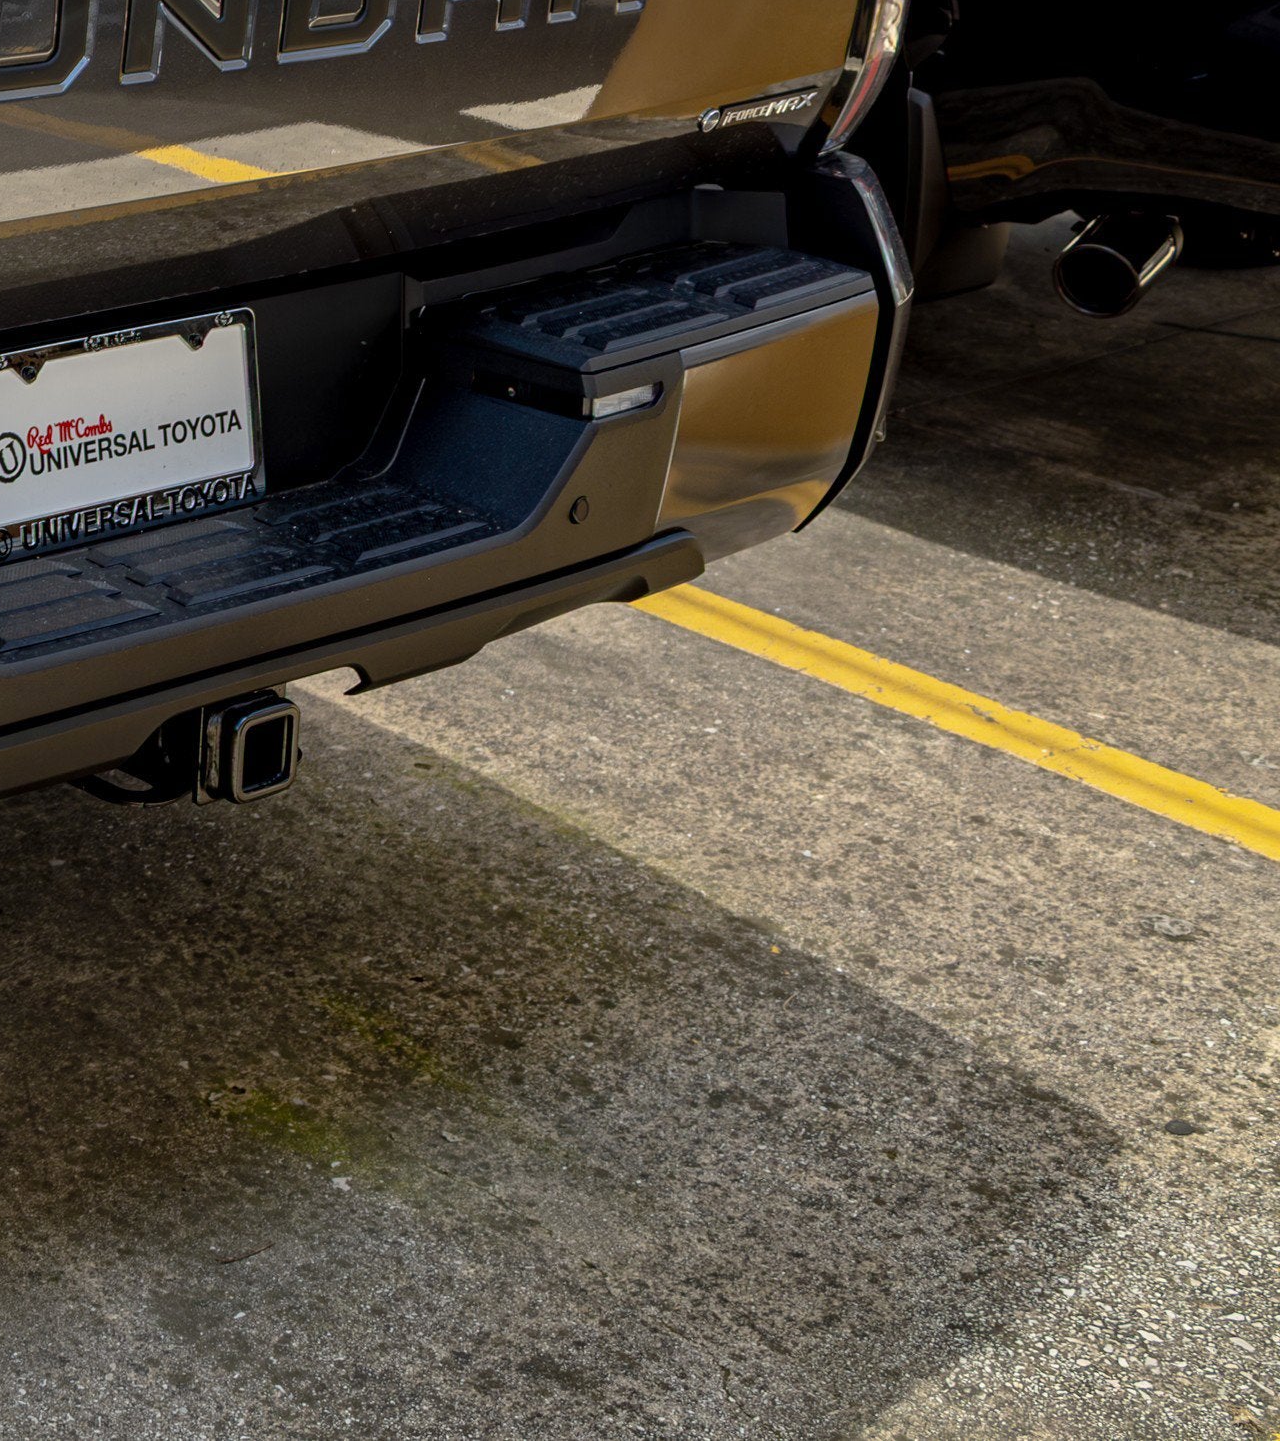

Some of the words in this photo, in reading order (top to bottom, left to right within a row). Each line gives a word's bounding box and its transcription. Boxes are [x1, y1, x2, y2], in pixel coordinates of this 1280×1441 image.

[27, 425, 53, 455] Red
[54, 414, 113, 442] McCombs
[29, 426, 155, 476] UNIVERSAL
[158, 409, 242, 447] TOYOTA
[20, 495, 164, 551] UNIVERSAL
[163, 473, 257, 515] TOYOTA
